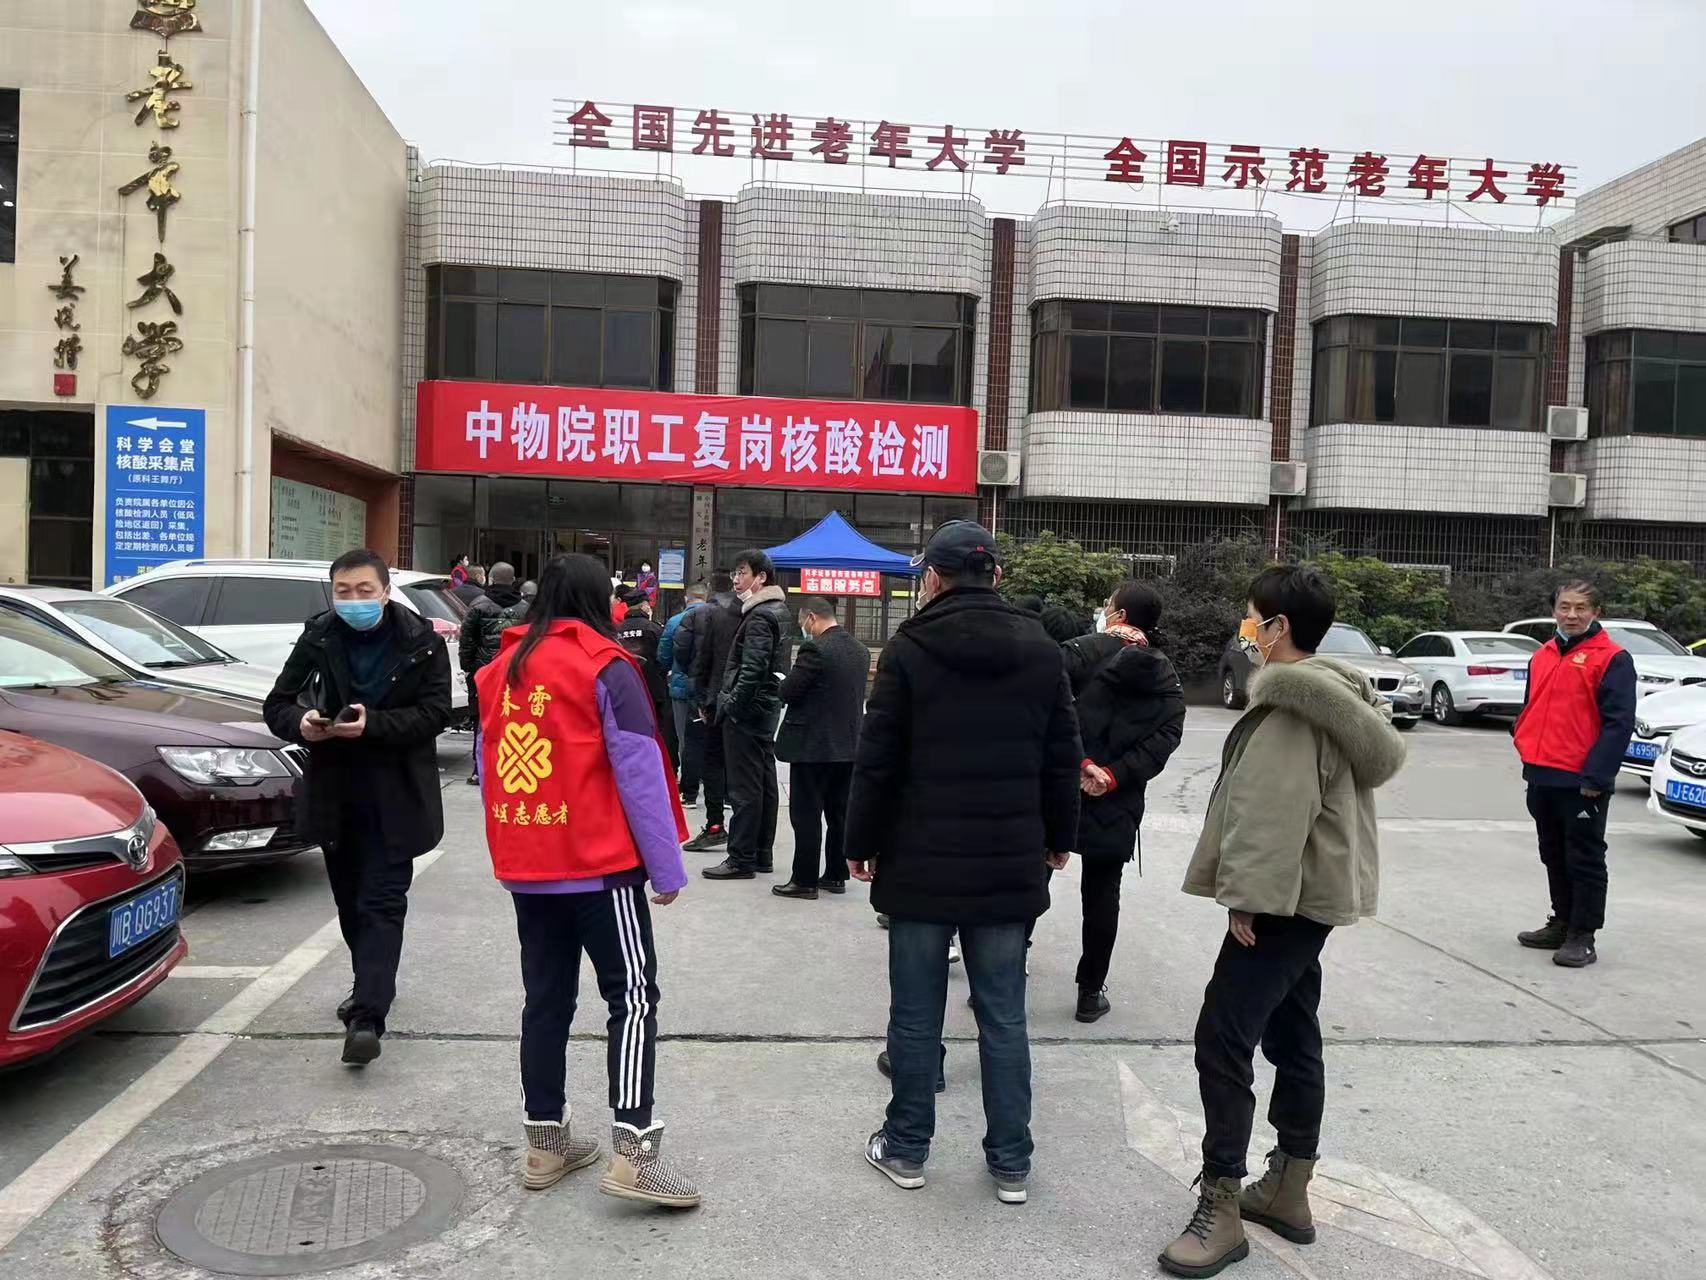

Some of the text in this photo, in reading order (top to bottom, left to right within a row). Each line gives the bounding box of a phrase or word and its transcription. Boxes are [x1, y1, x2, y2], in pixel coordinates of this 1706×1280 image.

[566, 100, 1566, 206] 全国先进老年大学 全国示范老年大学
[117, 50, 193, 400] 老年大学
[116, 436, 195, 454] 科学会堂
[464, 399, 950, 480] 中物院职工复岗核酸检测
[116, 455, 195, 472] 核酸采集点
[115, 541, 195, 553] 定定期检测的人员等
[806, 578, 874, 592] 志愿服务点
